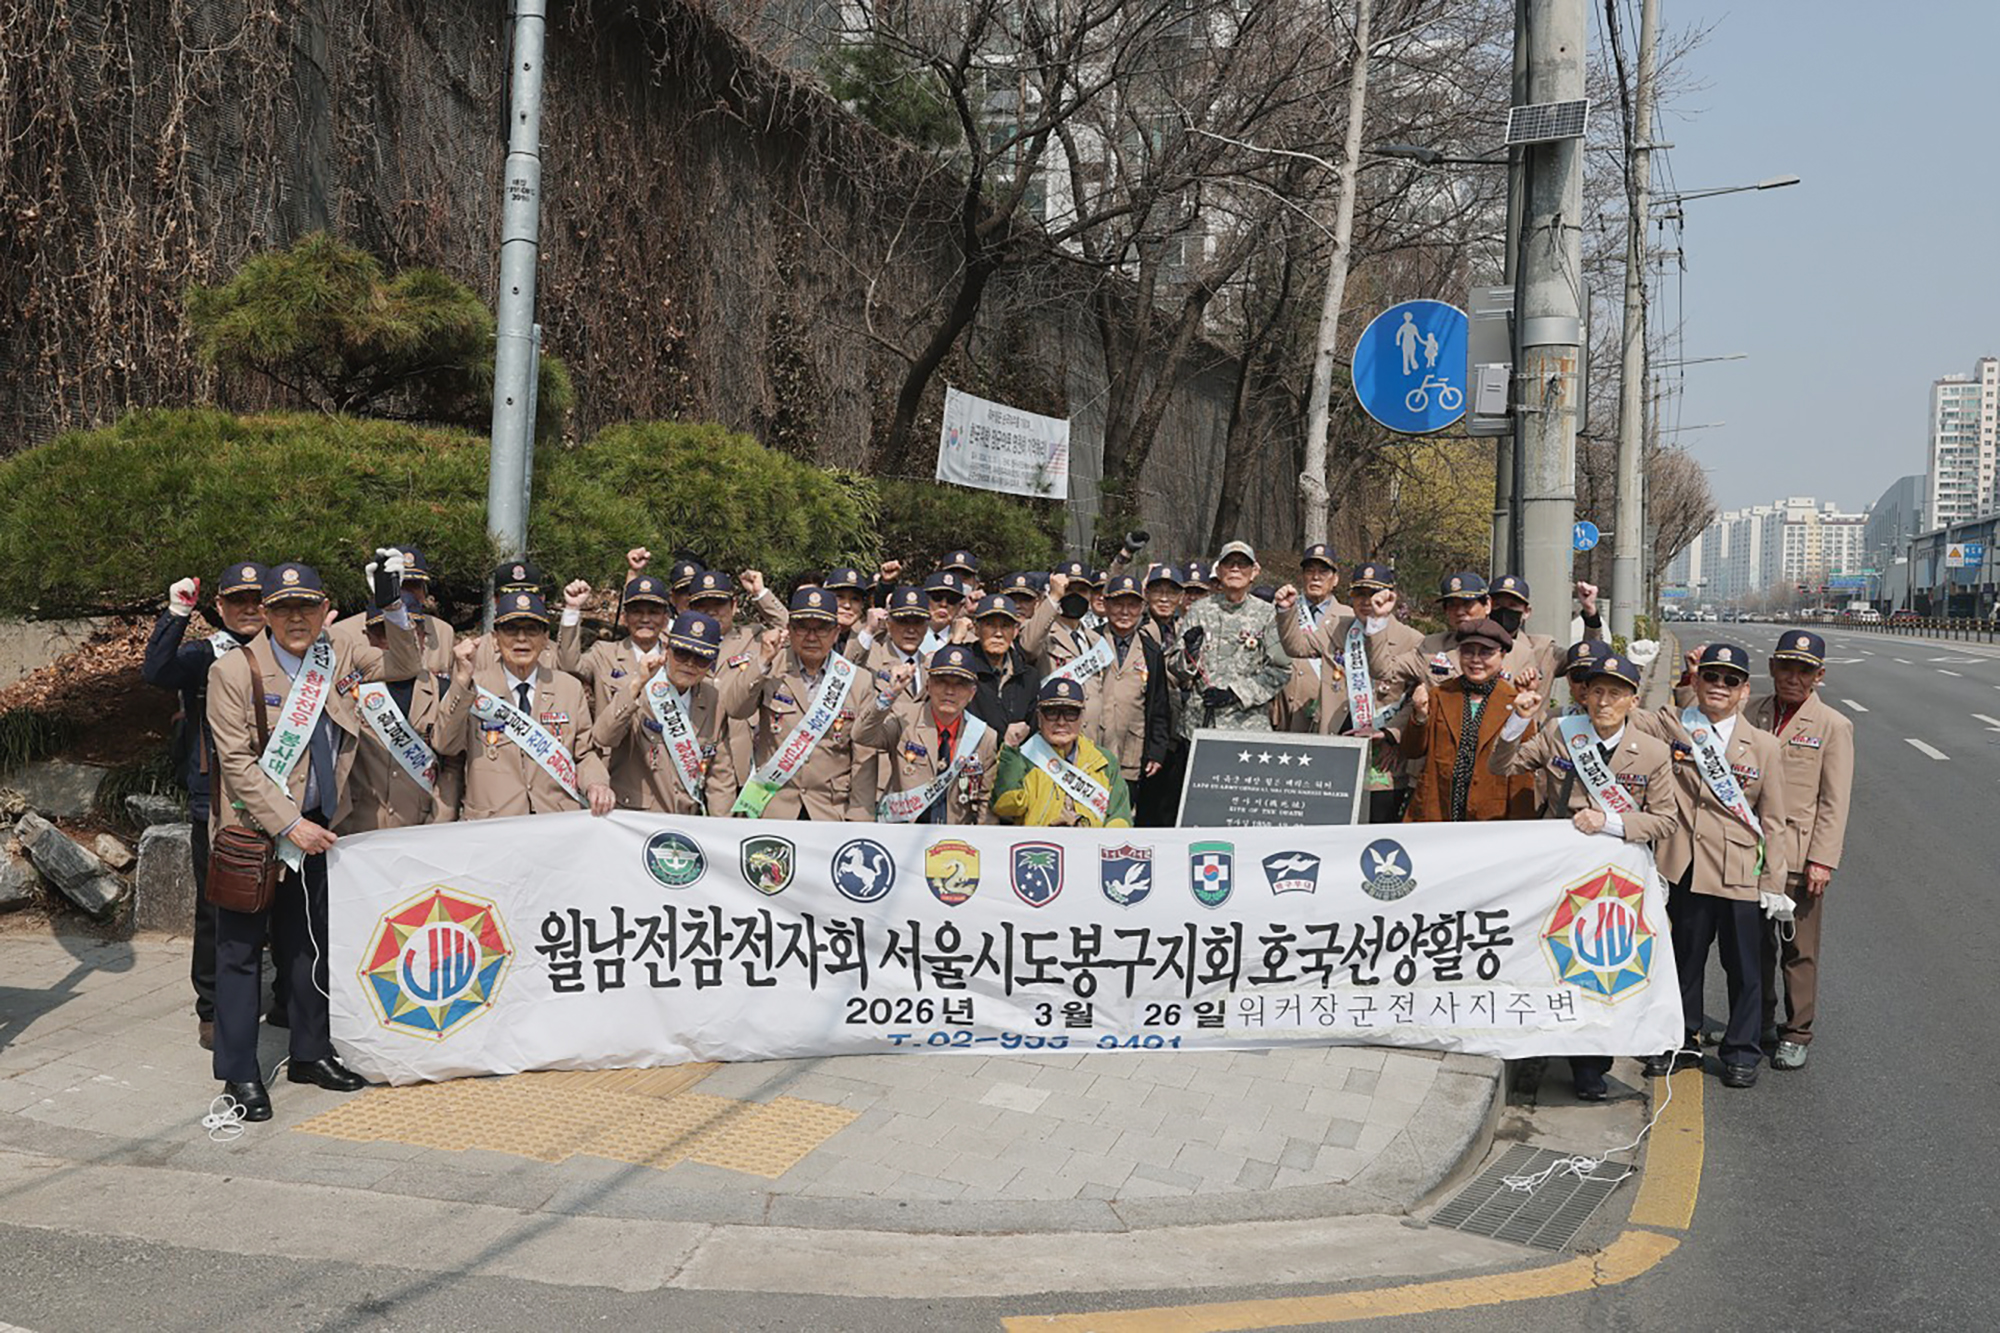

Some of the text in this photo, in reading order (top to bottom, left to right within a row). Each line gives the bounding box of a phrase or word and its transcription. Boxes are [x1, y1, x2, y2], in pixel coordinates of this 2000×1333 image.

[377, 709, 412, 748] 월남전
[494, 704, 530, 736] 월남전
[526, 730, 551, 756] 전우
[660, 699, 687, 738] 월남전
[269, 732, 300, 776] 봉사대
[1578, 750, 1609, 787] 월남전
[535, 905, 1514, 998] 월남전참전자회 서울시도봉구지회 호국선양활동
